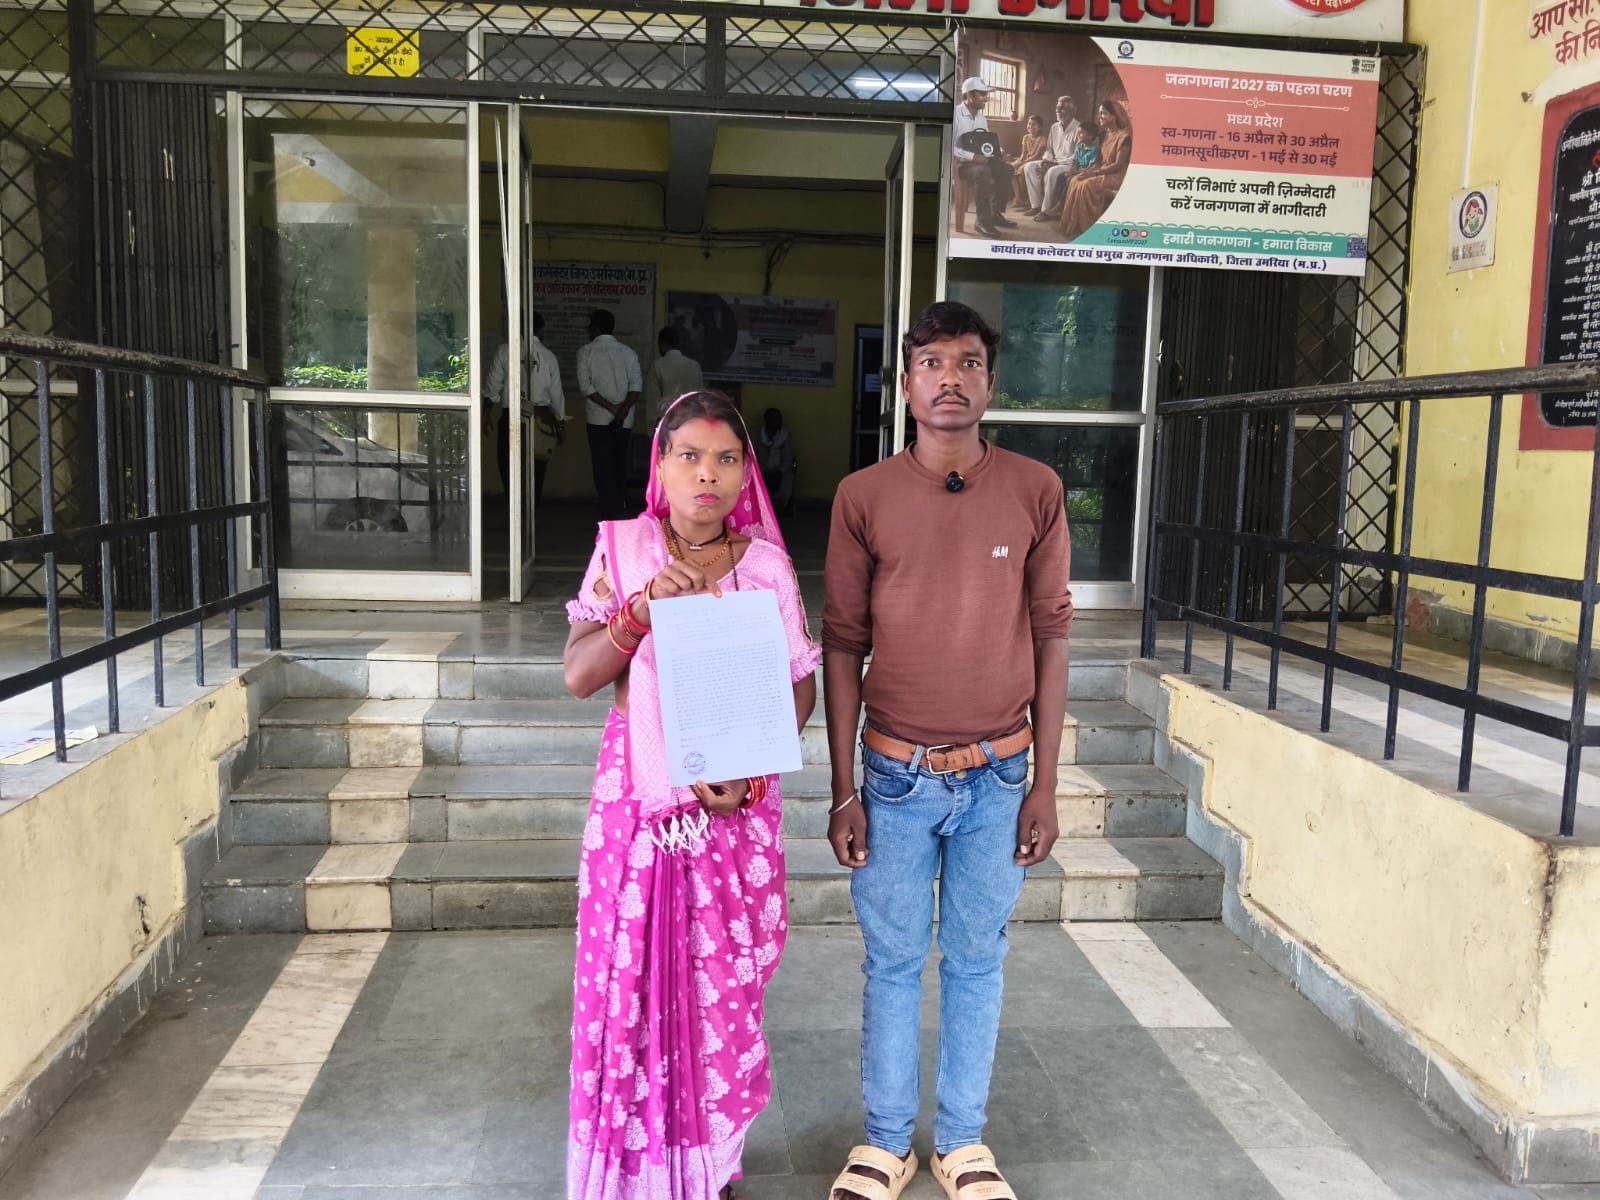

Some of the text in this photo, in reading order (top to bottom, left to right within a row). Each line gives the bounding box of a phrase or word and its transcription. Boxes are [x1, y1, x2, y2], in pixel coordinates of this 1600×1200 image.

[1555, 30, 1582, 64] की
[1165, 73, 1353, 98] जनगणना 2027 का पहला चरण
[1227, 112, 1284, 129] मध्य प्रदेश
[1161, 127, 1216, 141] स्व-गणना
[1227, 131, 1241, 142] 16
[1243, 128, 1275, 145] अप्रैल
[1277, 130, 1288, 145] से
[1290, 135, 1306, 147] 30
[1308, 131, 1340, 149] अप्रैल
[1161, 143, 1249, 162] मकानसूचीकरण
[1260, 151, 1266, 162] 1
[1268, 149, 1286, 165] मई
[1288, 149, 1299, 164] से
[1301, 153, 1317, 166] 30
[1320, 151, 1338, 168] मई
[1196, 176, 1237, 193] निभाएं
[1239, 179, 1275, 196] अपनी
[1277, 181, 1336, 200] ज़िम्मेदारी
[1170, 195, 1327, 218] करें जनगणना में भागीदारी
[1162, 230, 1194, 246] हमारी
[1196, 233, 1251, 248] जनगणना
[1262, 238, 1293, 251] हमारा
[1295, 237, 1333, 253] विकास
[991, 243, 1328, 271] कार्यालय कलेक्टर एवं प्रमुख जनगणना अधिकारी, जिला उमरिया (म.प्र.)
